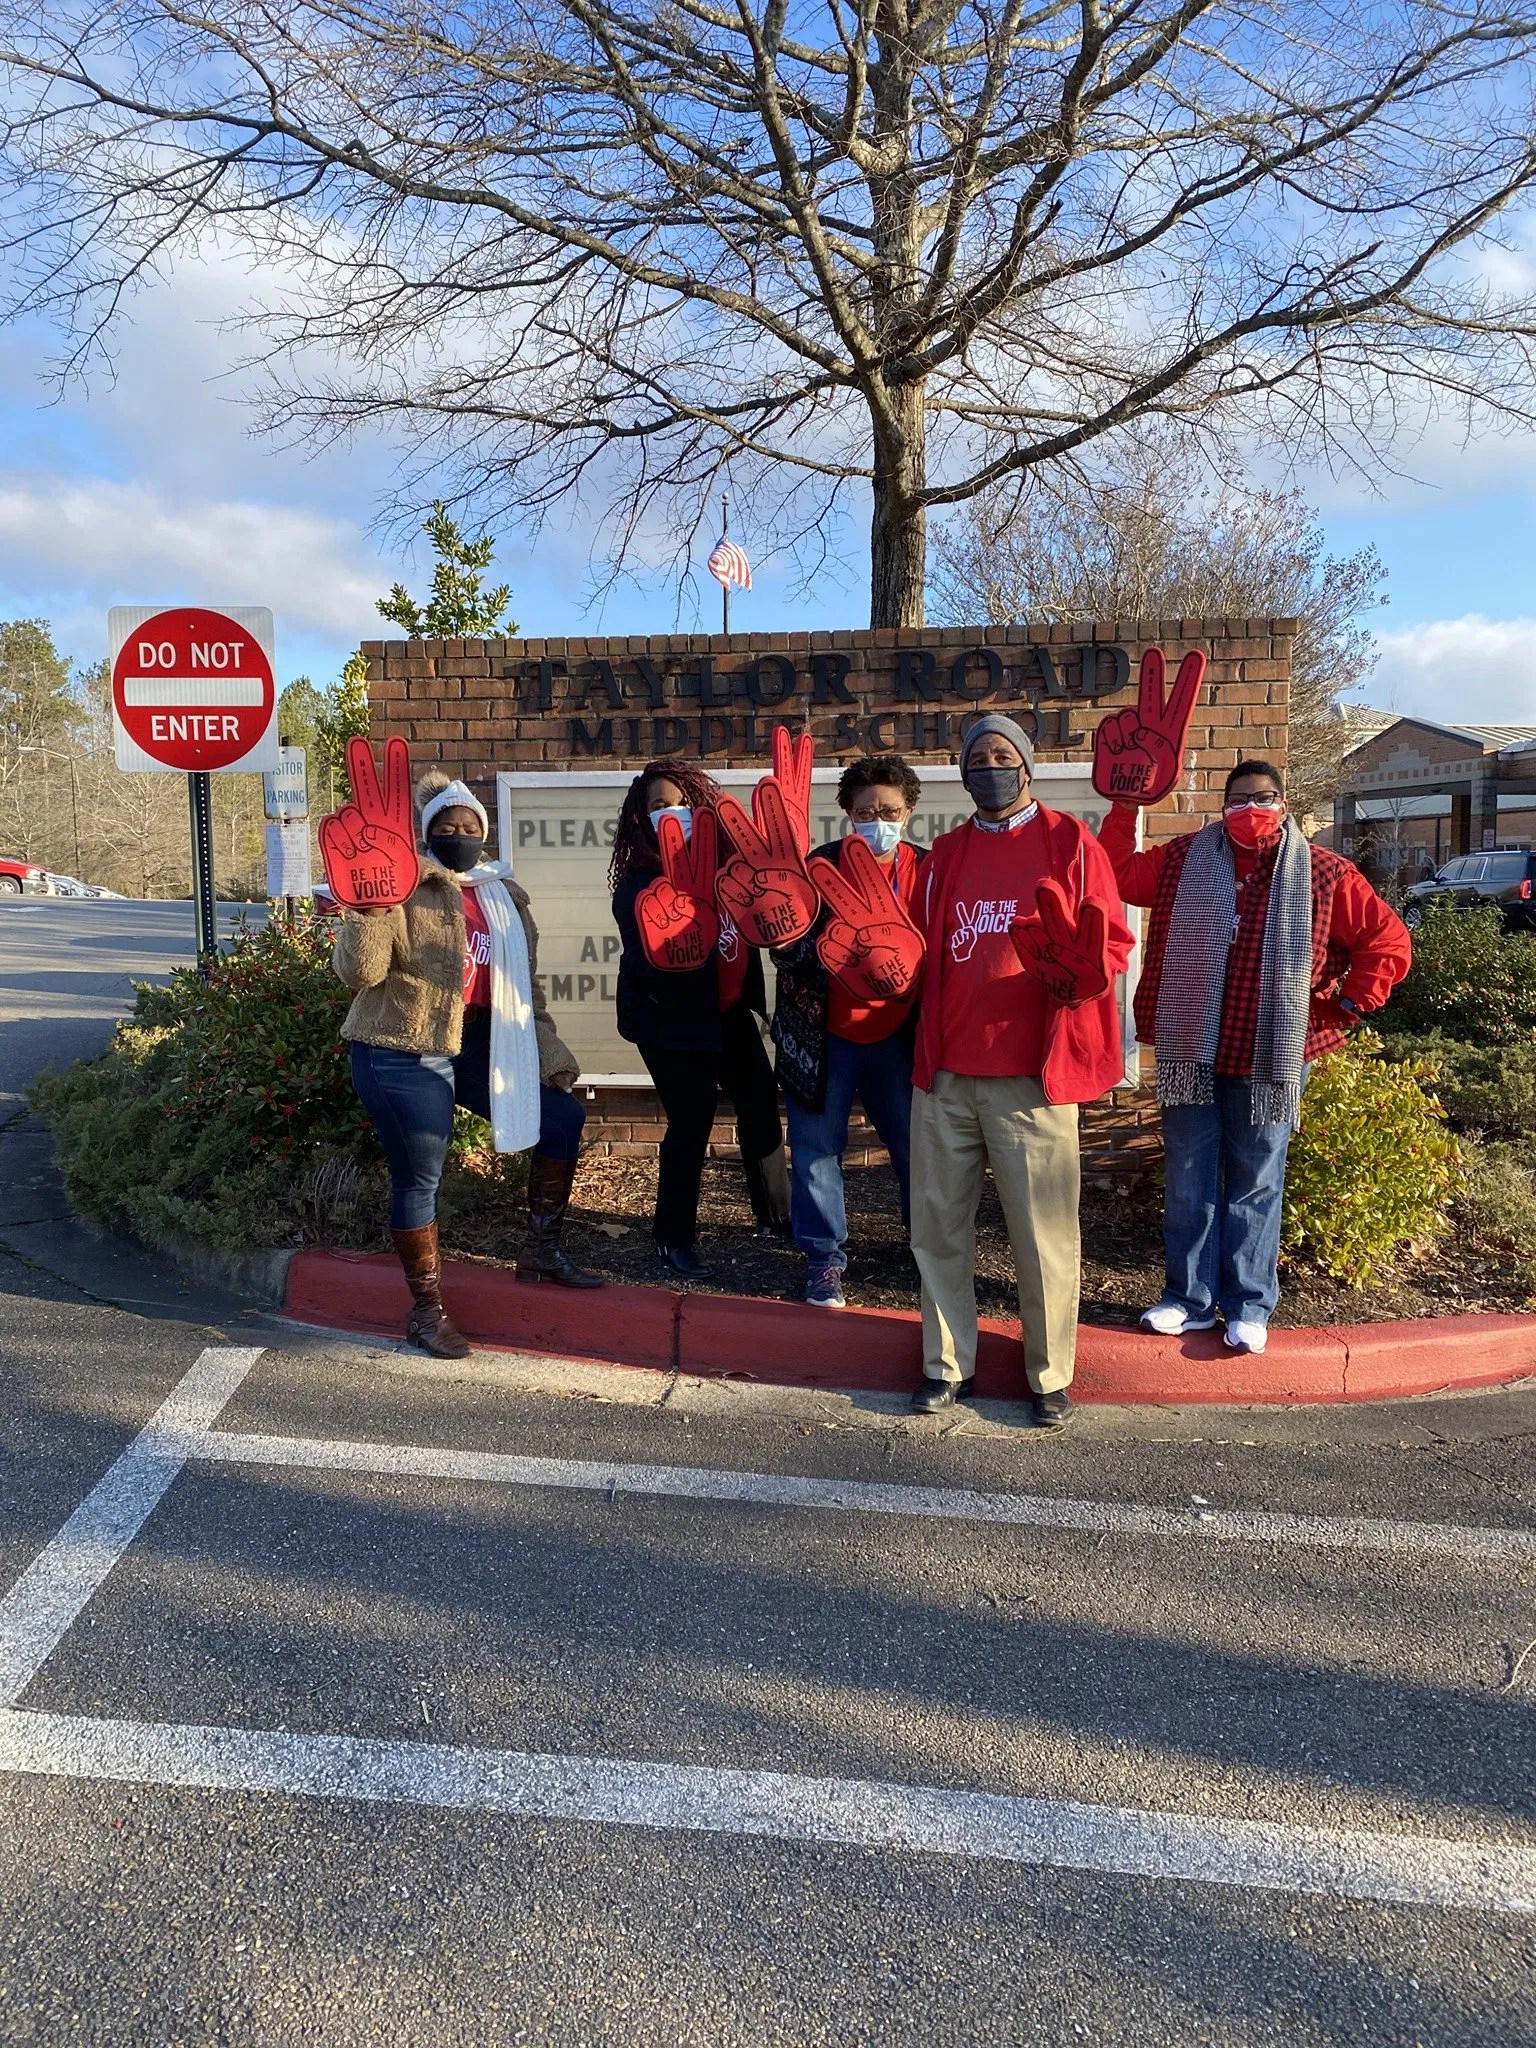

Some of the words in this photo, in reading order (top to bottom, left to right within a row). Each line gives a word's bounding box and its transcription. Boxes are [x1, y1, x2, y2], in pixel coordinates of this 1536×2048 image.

[139, 642, 176, 669] DO
[191, 642, 245, 668] NOT
[525, 653, 859, 710] TAYLOR
[896, 646, 1131, 701] ROAD
[151, 715, 240, 741] ENTER
[359, 759, 371, 796] MAKE
[1111, 763, 1125, 774] BE
[1130, 763, 1153, 777] THE
[1110, 775, 1151, 795] VOICE
[267, 790, 305, 804] PARKING
[350, 868, 366, 881] BE
[372, 866, 395, 879] THE
[753, 911, 768, 925] BE
[770, 901, 795, 919] THE
[982, 901, 997, 914] BE
[998, 900, 1018, 913] THE
[664, 936, 679, 948] BE
[684, 930, 704, 946] THE
[666, 943, 705, 965] VOICE
[878, 954, 904, 976] THE
